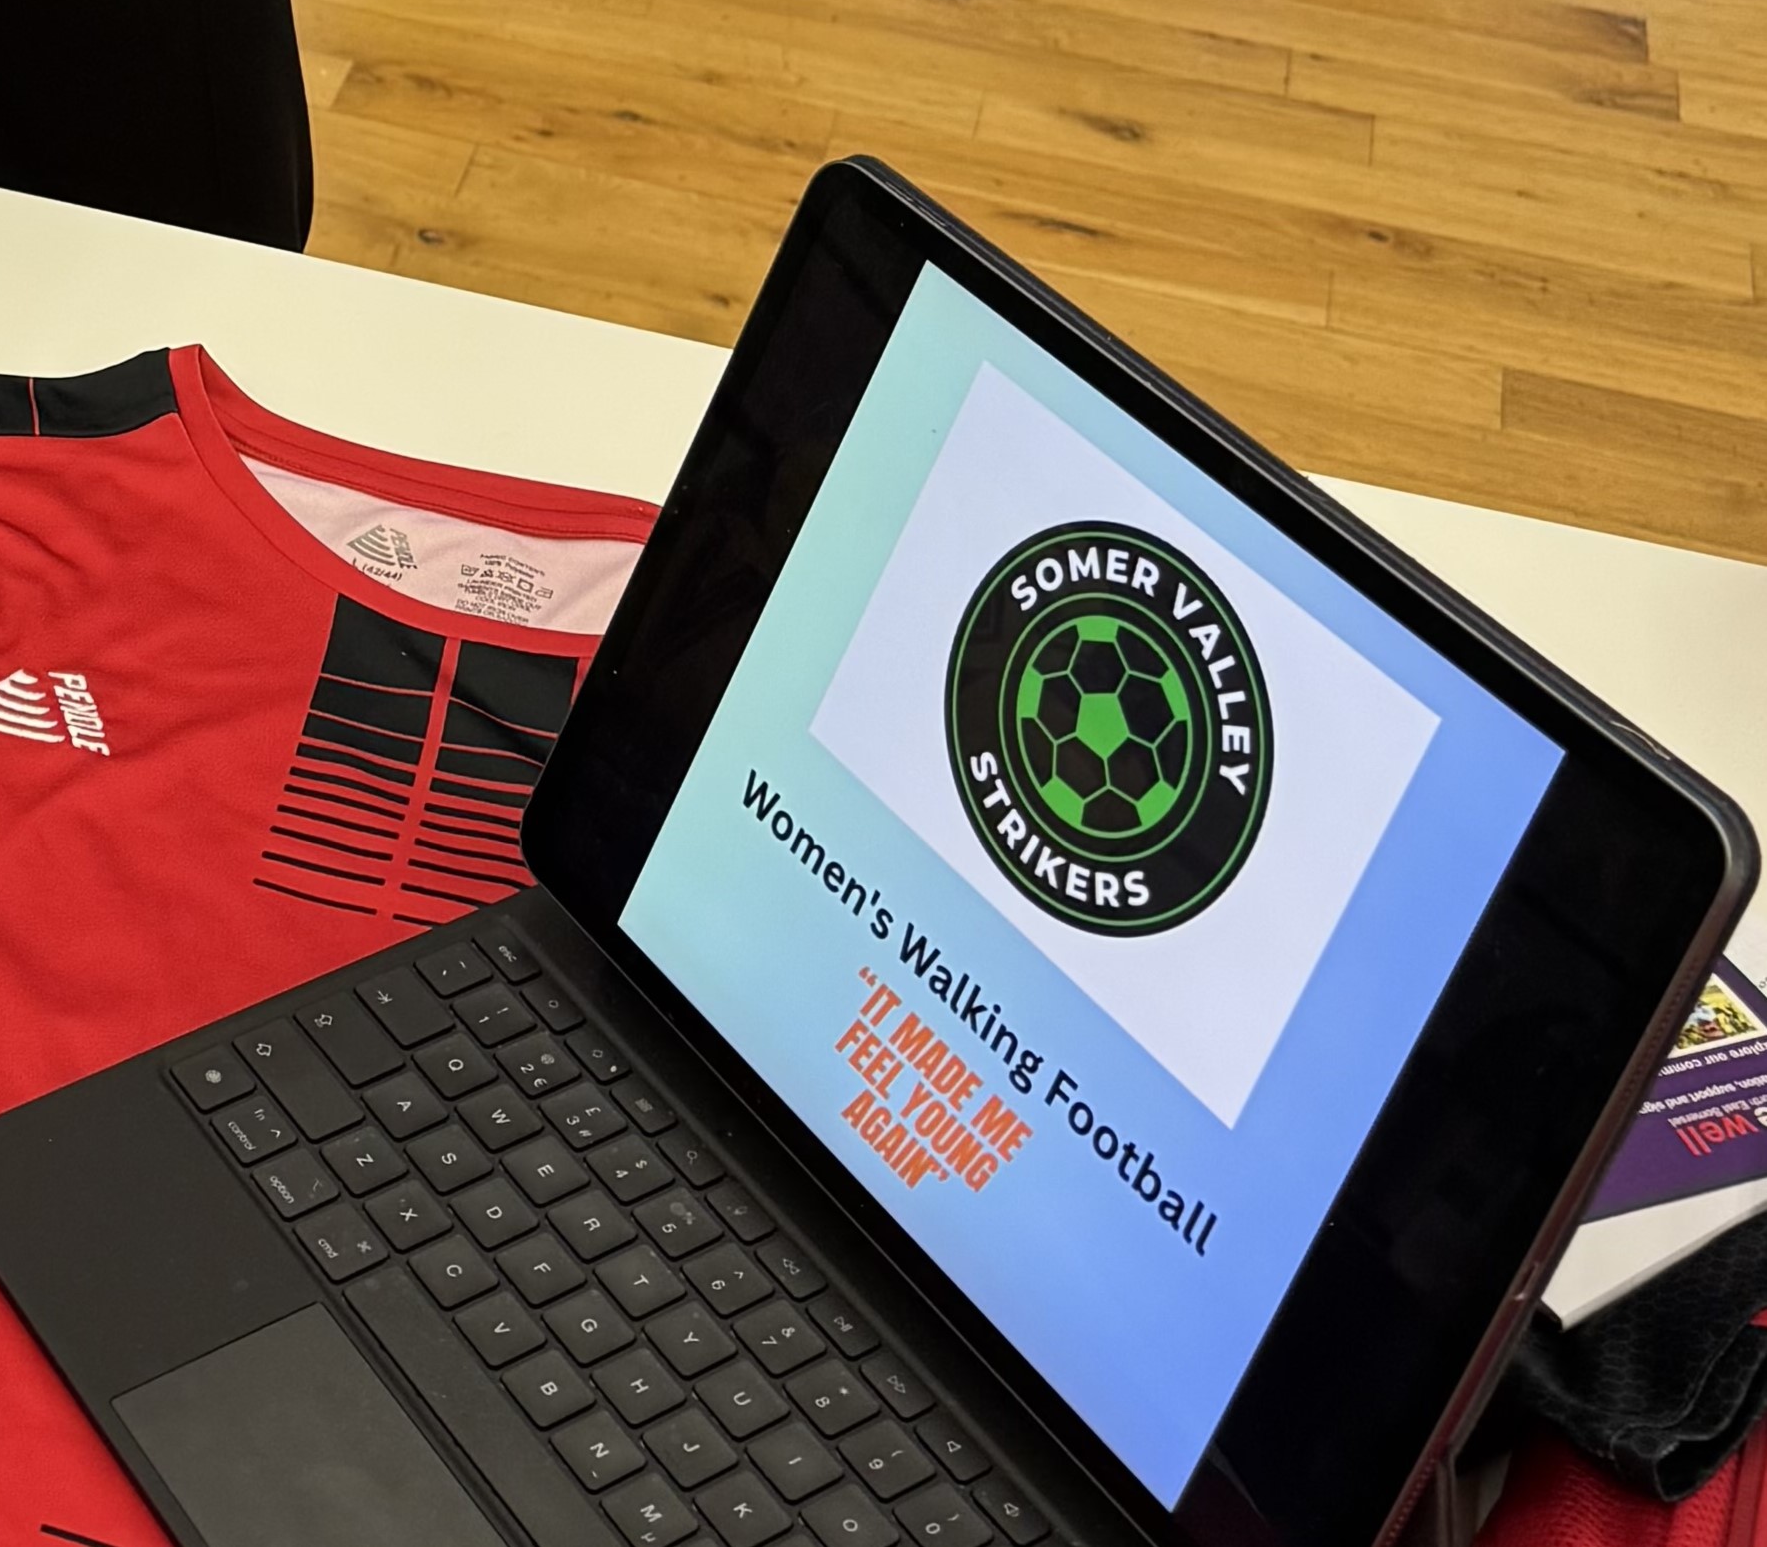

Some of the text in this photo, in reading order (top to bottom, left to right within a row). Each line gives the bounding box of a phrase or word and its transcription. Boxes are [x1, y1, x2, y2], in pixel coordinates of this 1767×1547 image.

[1009, 547, 1250, 797] SOMER VALLEY
[48, 671, 110, 756] PENDLE
[968, 749, 1152, 908] STRIKERS
[741, 768, 1221, 1257] Women's Walking Football
[1704, 1052, 1728, 1065] our
[521, 1064, 534, 1073] 2
[1658, 1059, 1702, 1077] comm
[888, 1011, 983, 1113] MADE
[970, 1094, 1033, 1163] ME
[1689, 1084, 1736, 1102] support
[397, 1100, 412, 1112] A
[835, 1019, 999, 1193] FEEL YOUNG
[1665, 1094, 1689, 1110] and
[491, 1109, 511, 1125] W
[566, 1116, 580, 1125] 3
[1668, 1107, 1724, 1129] Somerset
[227, 1121, 256, 1151] control
[1676, 1113, 1759, 1156] well
[356, 1154, 374, 1167] Z
[441, 1153, 457, 1164] S
[537, 1163, 554, 1177] E
[270, 1175, 294, 1204] option
[400, 1208, 418, 1221] X
[486, 1206, 502, 1219] D
[584, 1218, 600, 1231] R
[318, 1238, 339, 1258] cmd
[446, 1264, 462, 1277] C
[533, 1262, 551, 1274] F
[633, 1274, 649, 1286] T
[711, 1280, 725, 1290] 6
[494, 1322, 510, 1334] V
[581, 1318, 597, 1333] G
[683, 1332, 700, 1344] Y
[762, 1336, 777, 1347] 7
[540, 1381, 559, 1396] B
[630, 1379, 649, 1394] H
[733, 1392, 751, 1405] U
[815, 1396, 830, 1408] 8
[590, 1442, 609, 1458] N
[683, 1442, 700, 1452] J
[640, 1504, 662, 1523] M
[733, 1503, 752, 1518] K
